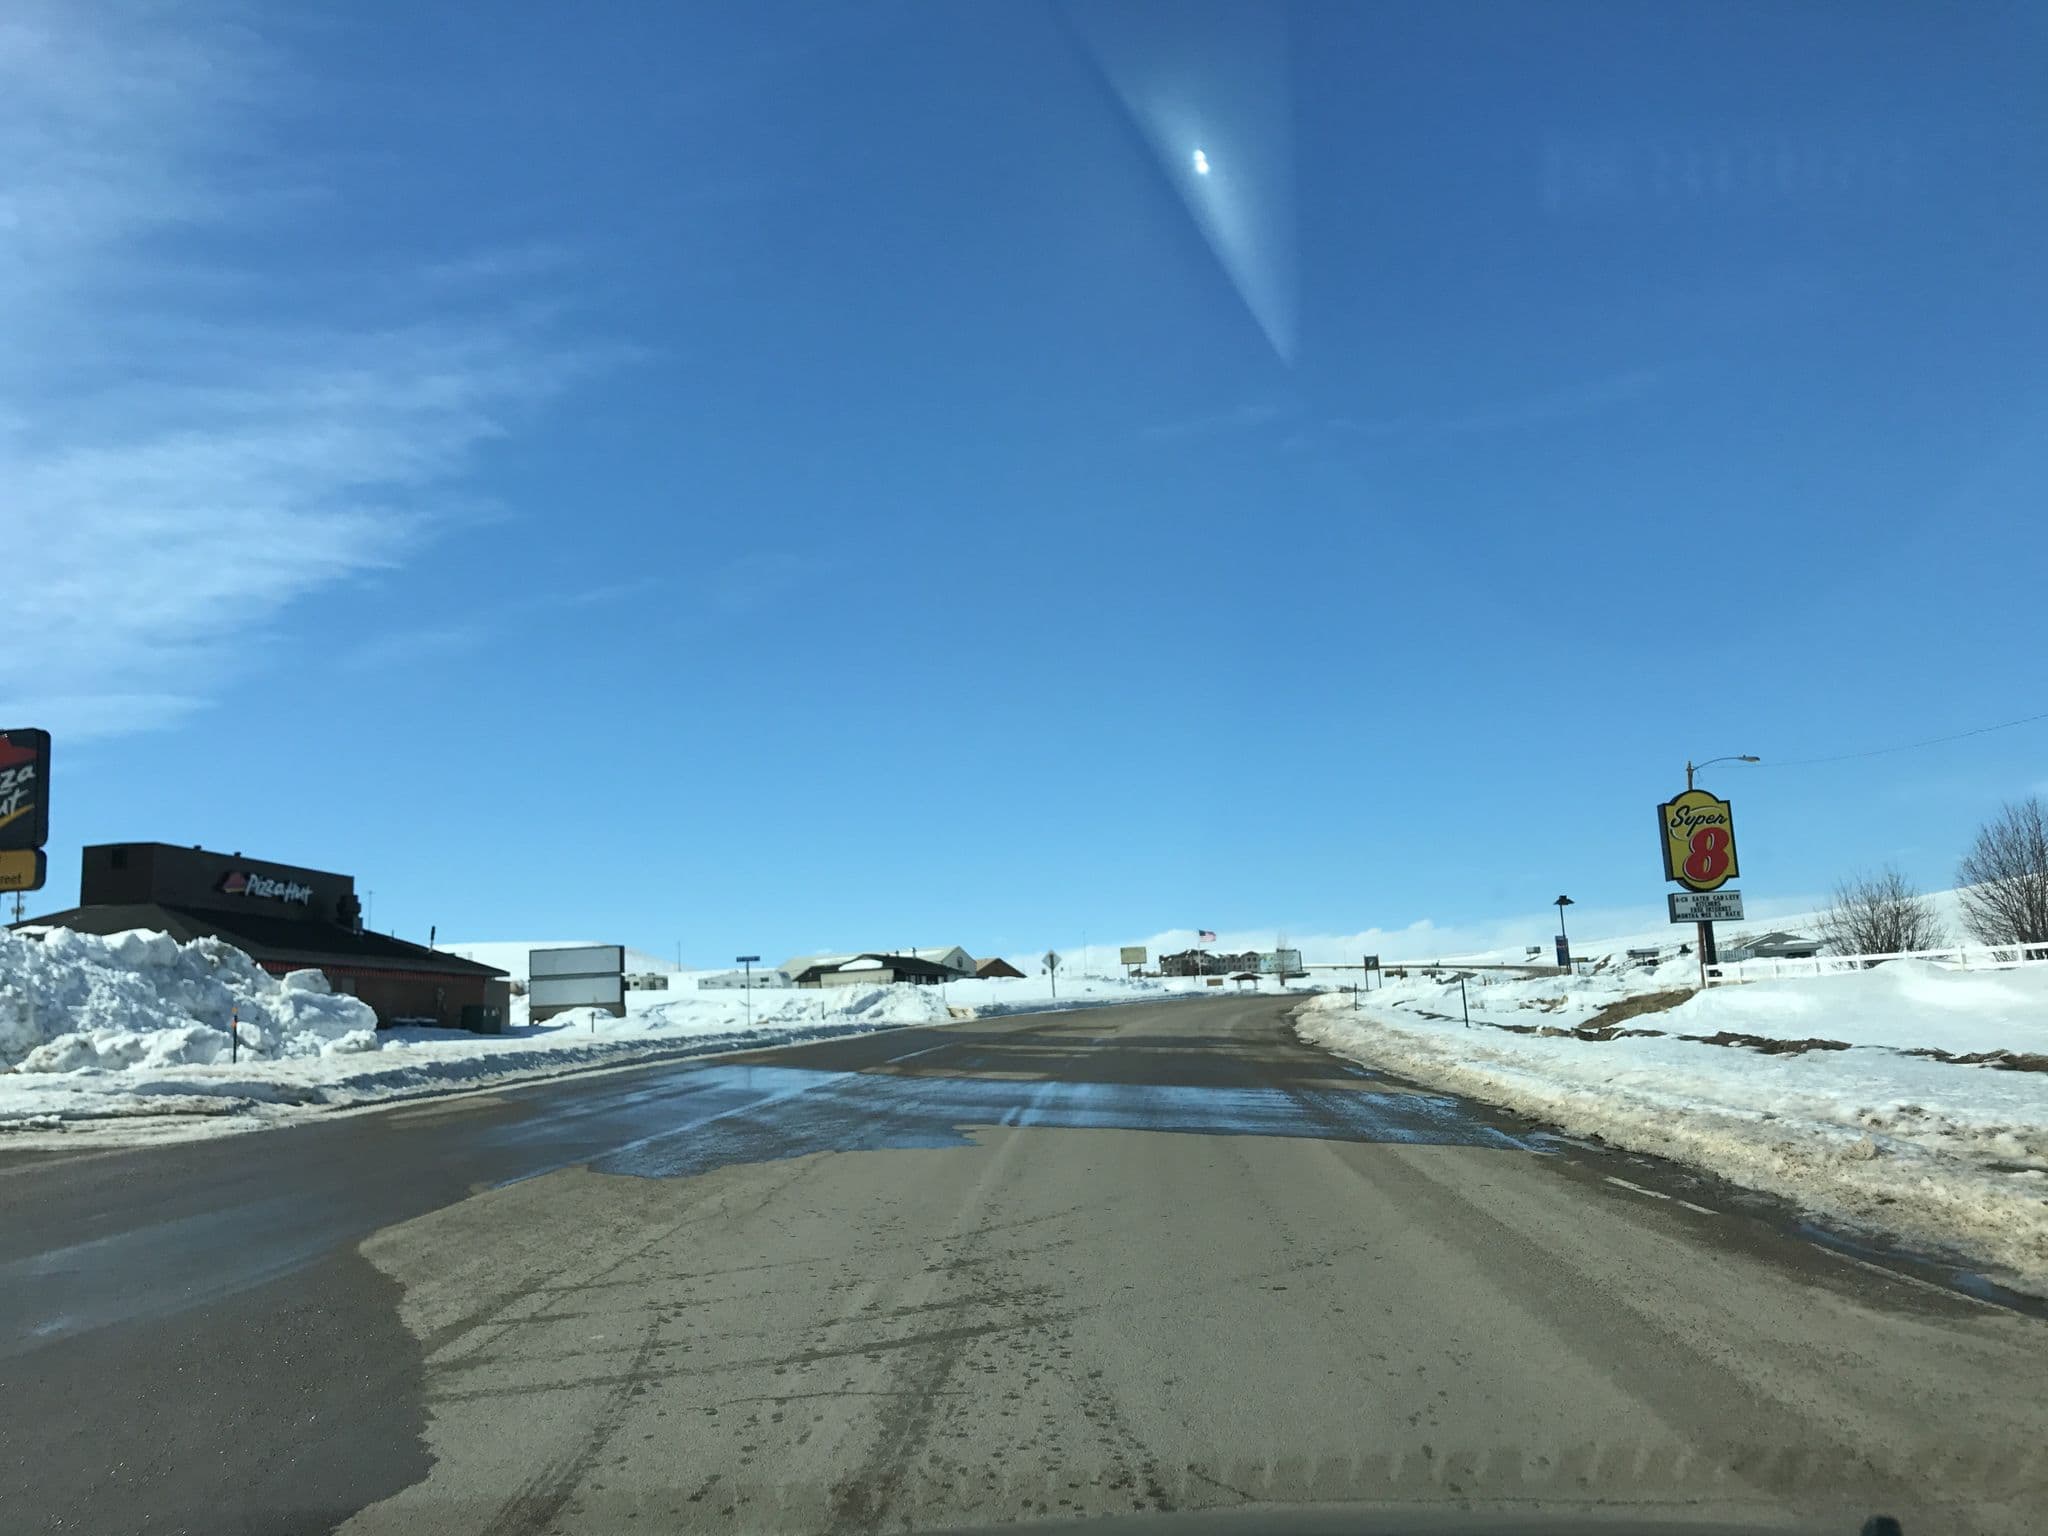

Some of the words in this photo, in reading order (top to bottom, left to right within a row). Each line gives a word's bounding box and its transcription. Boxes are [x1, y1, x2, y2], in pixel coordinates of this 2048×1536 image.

[1670, 805, 1728, 837] Super
[1683, 827, 1730, 882] 8
[244, 873, 285, 898] Pizza
